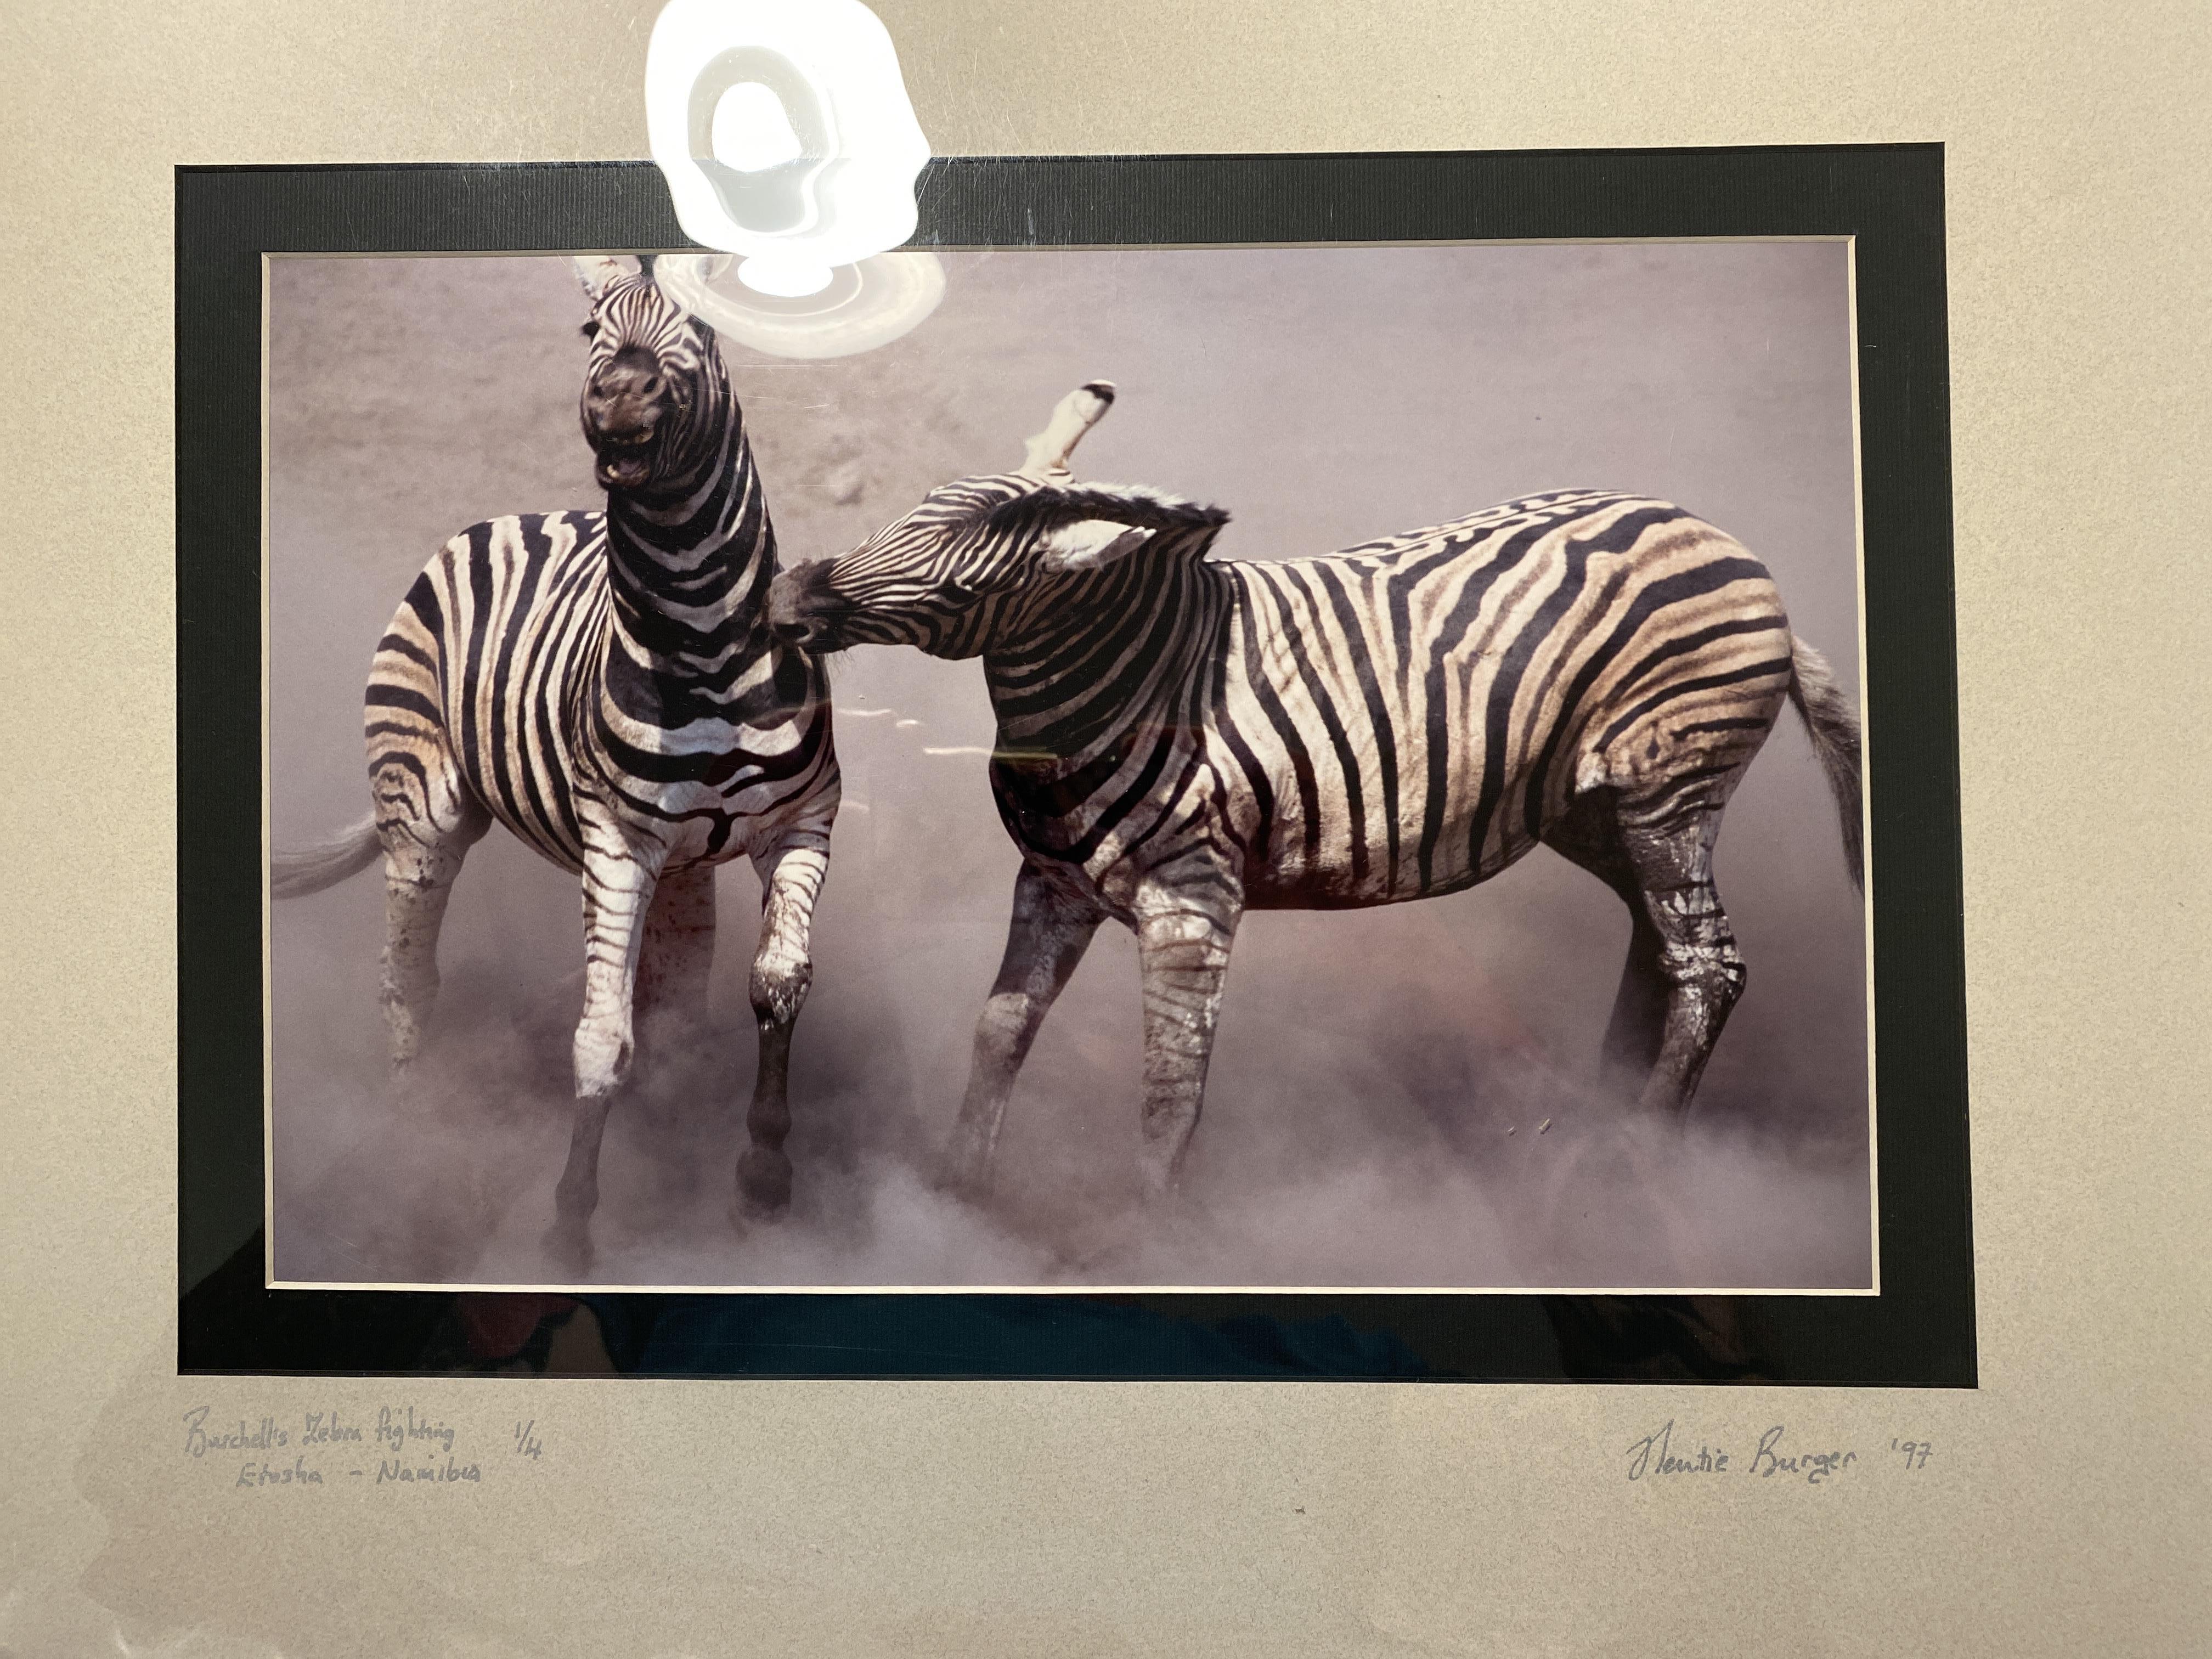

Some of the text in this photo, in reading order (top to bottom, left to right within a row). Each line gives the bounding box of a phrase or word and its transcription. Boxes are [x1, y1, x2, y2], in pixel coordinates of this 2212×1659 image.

[302, 1410, 362, 1446] Zebra
[514, 1419, 543, 1460] 1/4
[1748, 1425, 1857, 1484] Burger
[1891, 1437, 1933, 1470] '97
[235, 1455, 323, 1488] Etosha
[376, 1453, 482, 1485] Namibia
